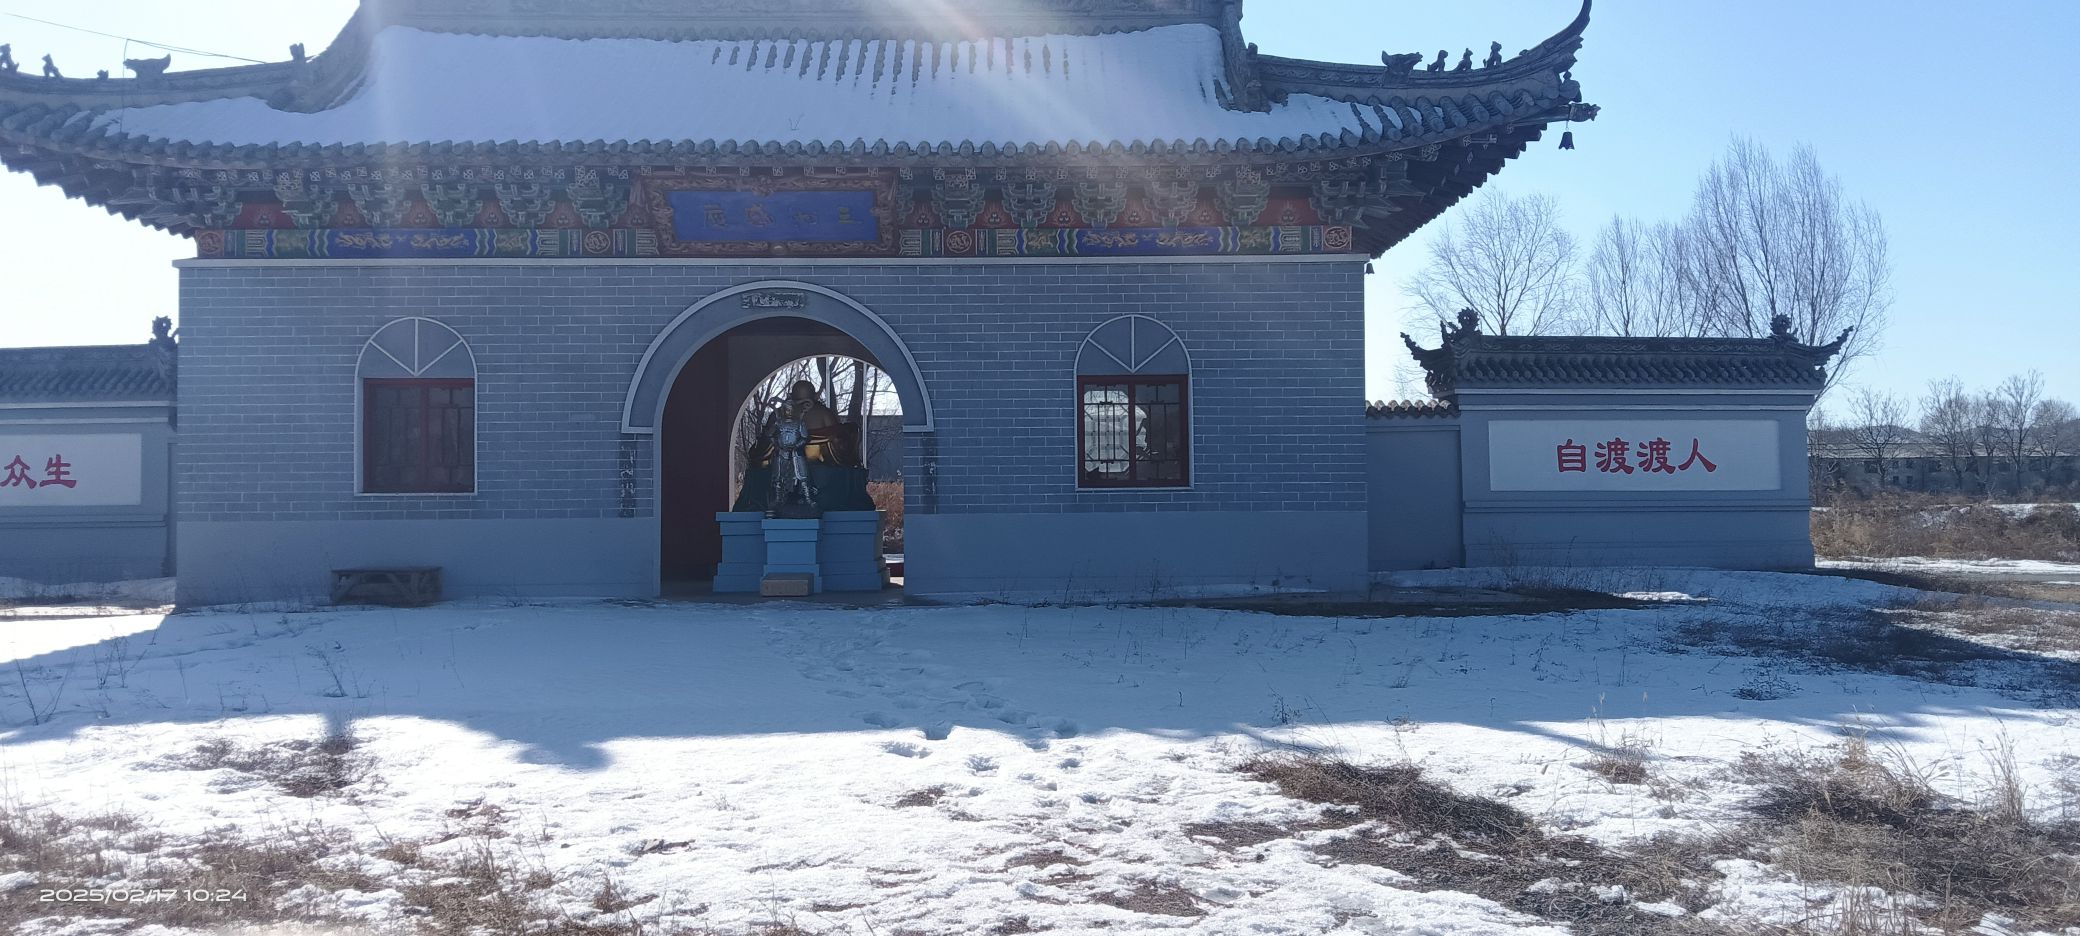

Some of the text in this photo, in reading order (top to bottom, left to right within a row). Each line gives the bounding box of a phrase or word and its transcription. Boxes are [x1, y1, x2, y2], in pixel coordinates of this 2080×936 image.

[0, 454, 77, 489] 众生
[1556, 437, 1718, 475] 自渡渡人
